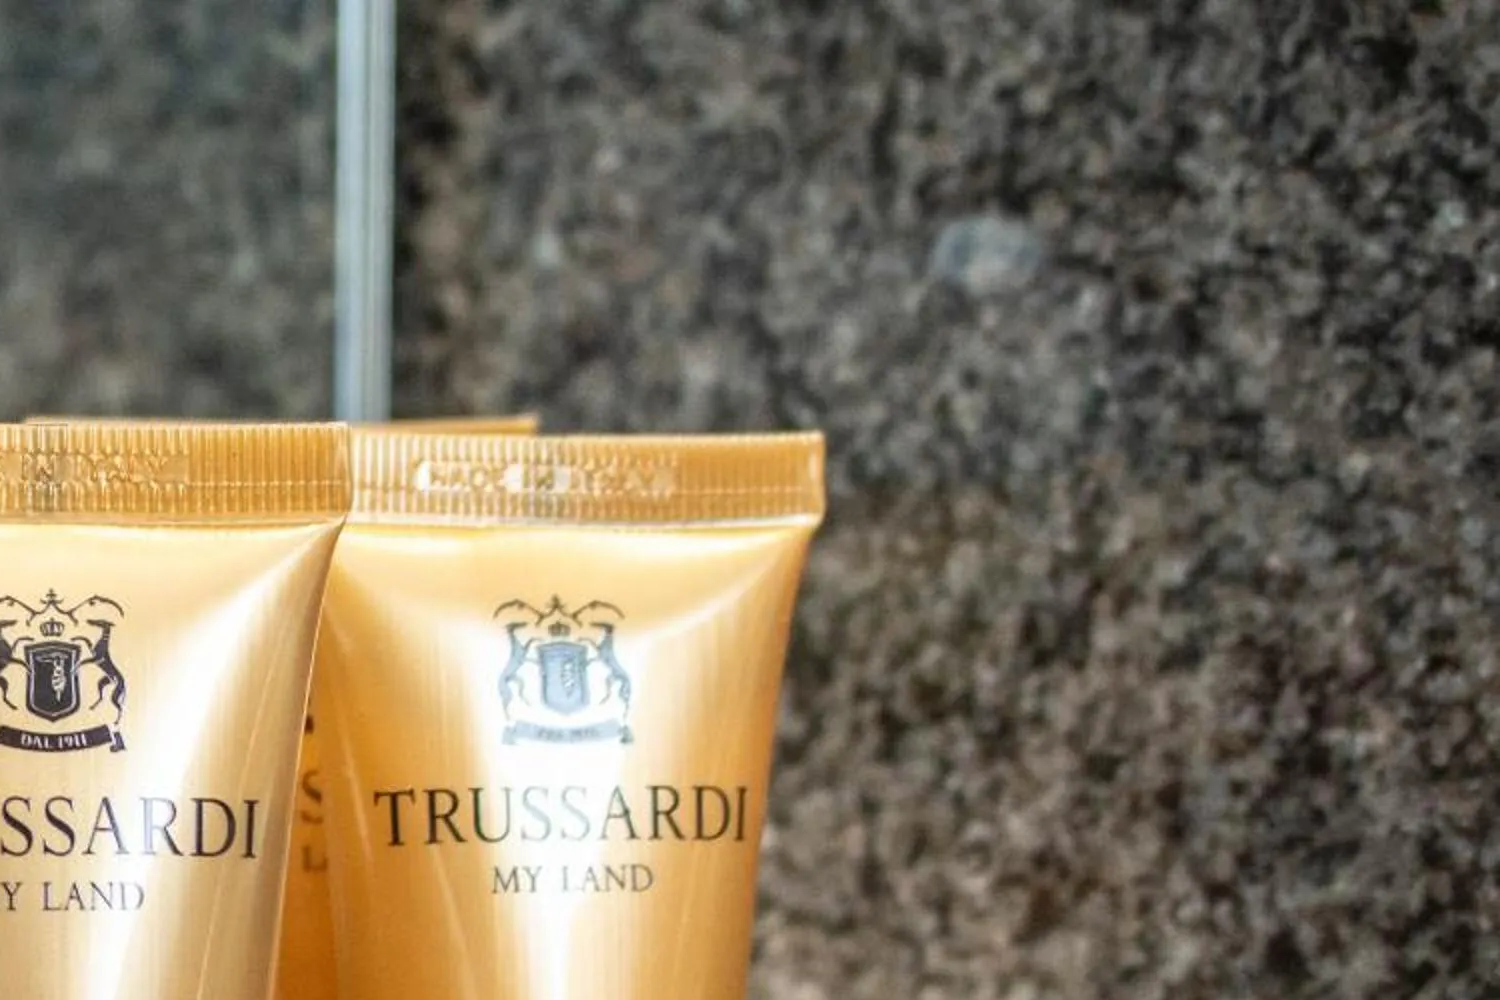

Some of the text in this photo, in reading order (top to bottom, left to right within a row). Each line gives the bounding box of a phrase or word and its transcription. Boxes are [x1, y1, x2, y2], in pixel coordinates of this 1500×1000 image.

[20, 732, 49, 749] DAL
[373, 784, 748, 847] TRUSSARDI
[491, 863, 655, 896] MY LAND
[42, 880, 146, 913] LAND
